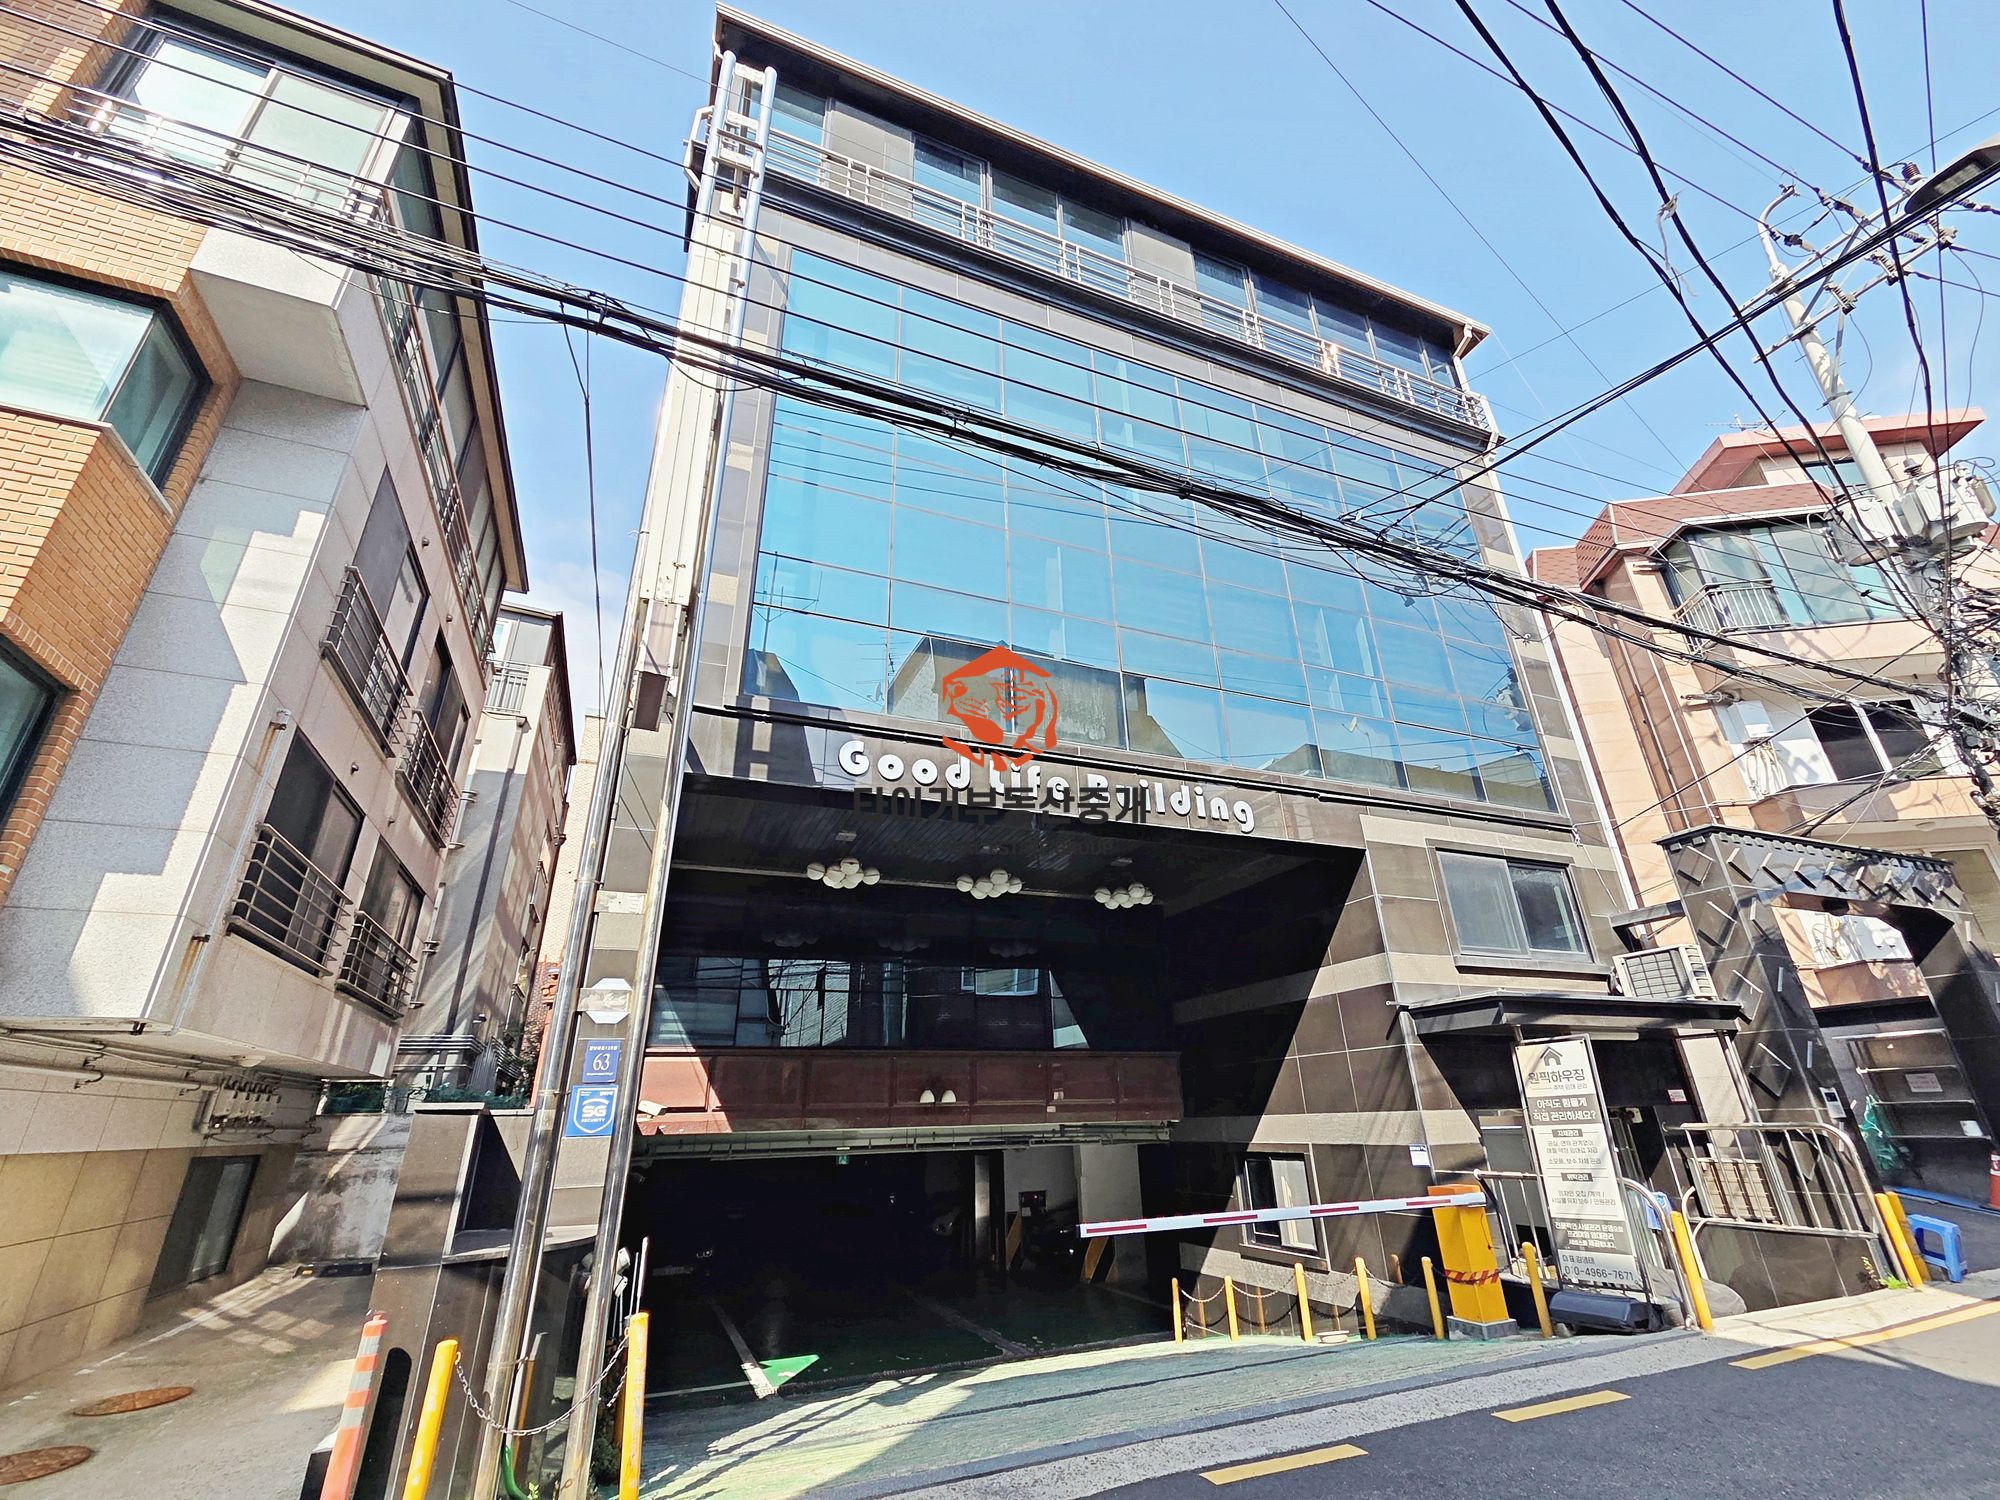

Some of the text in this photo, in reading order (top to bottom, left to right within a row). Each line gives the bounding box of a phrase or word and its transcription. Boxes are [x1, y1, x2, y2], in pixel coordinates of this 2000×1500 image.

[838, 740, 971, 791] Good
[1087, 773, 1255, 833] Building
[592, 1053, 610, 1071] 63
[1528, 1068, 1586, 1085] 원픽하우징
[1537, 1097, 1588, 1109] 아직도 힘들게
[581, 1105, 607, 1118] SG
[1533, 1110, 1596, 1122] 직접 관리하세요?
[1565, 1265, 1634, 1280] 00-4966-7671
